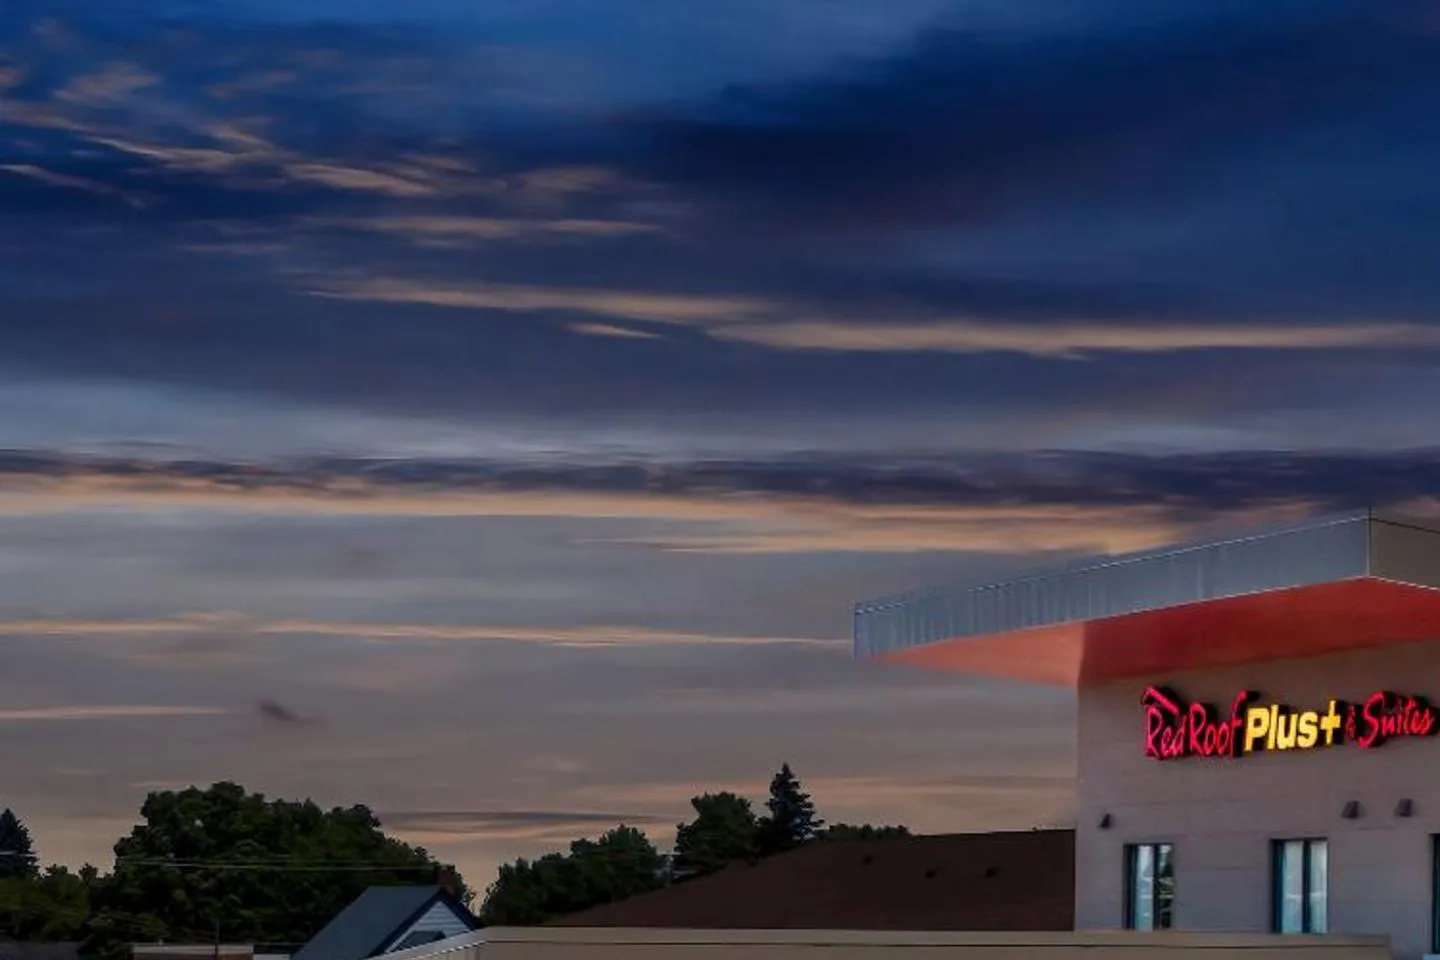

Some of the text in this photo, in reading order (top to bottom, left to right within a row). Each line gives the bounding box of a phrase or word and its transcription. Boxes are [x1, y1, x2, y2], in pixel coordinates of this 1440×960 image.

[1145, 703, 1187, 758] Red
[1190, 690, 1247, 757] Roof
[1358, 689, 1437, 748] Suites
